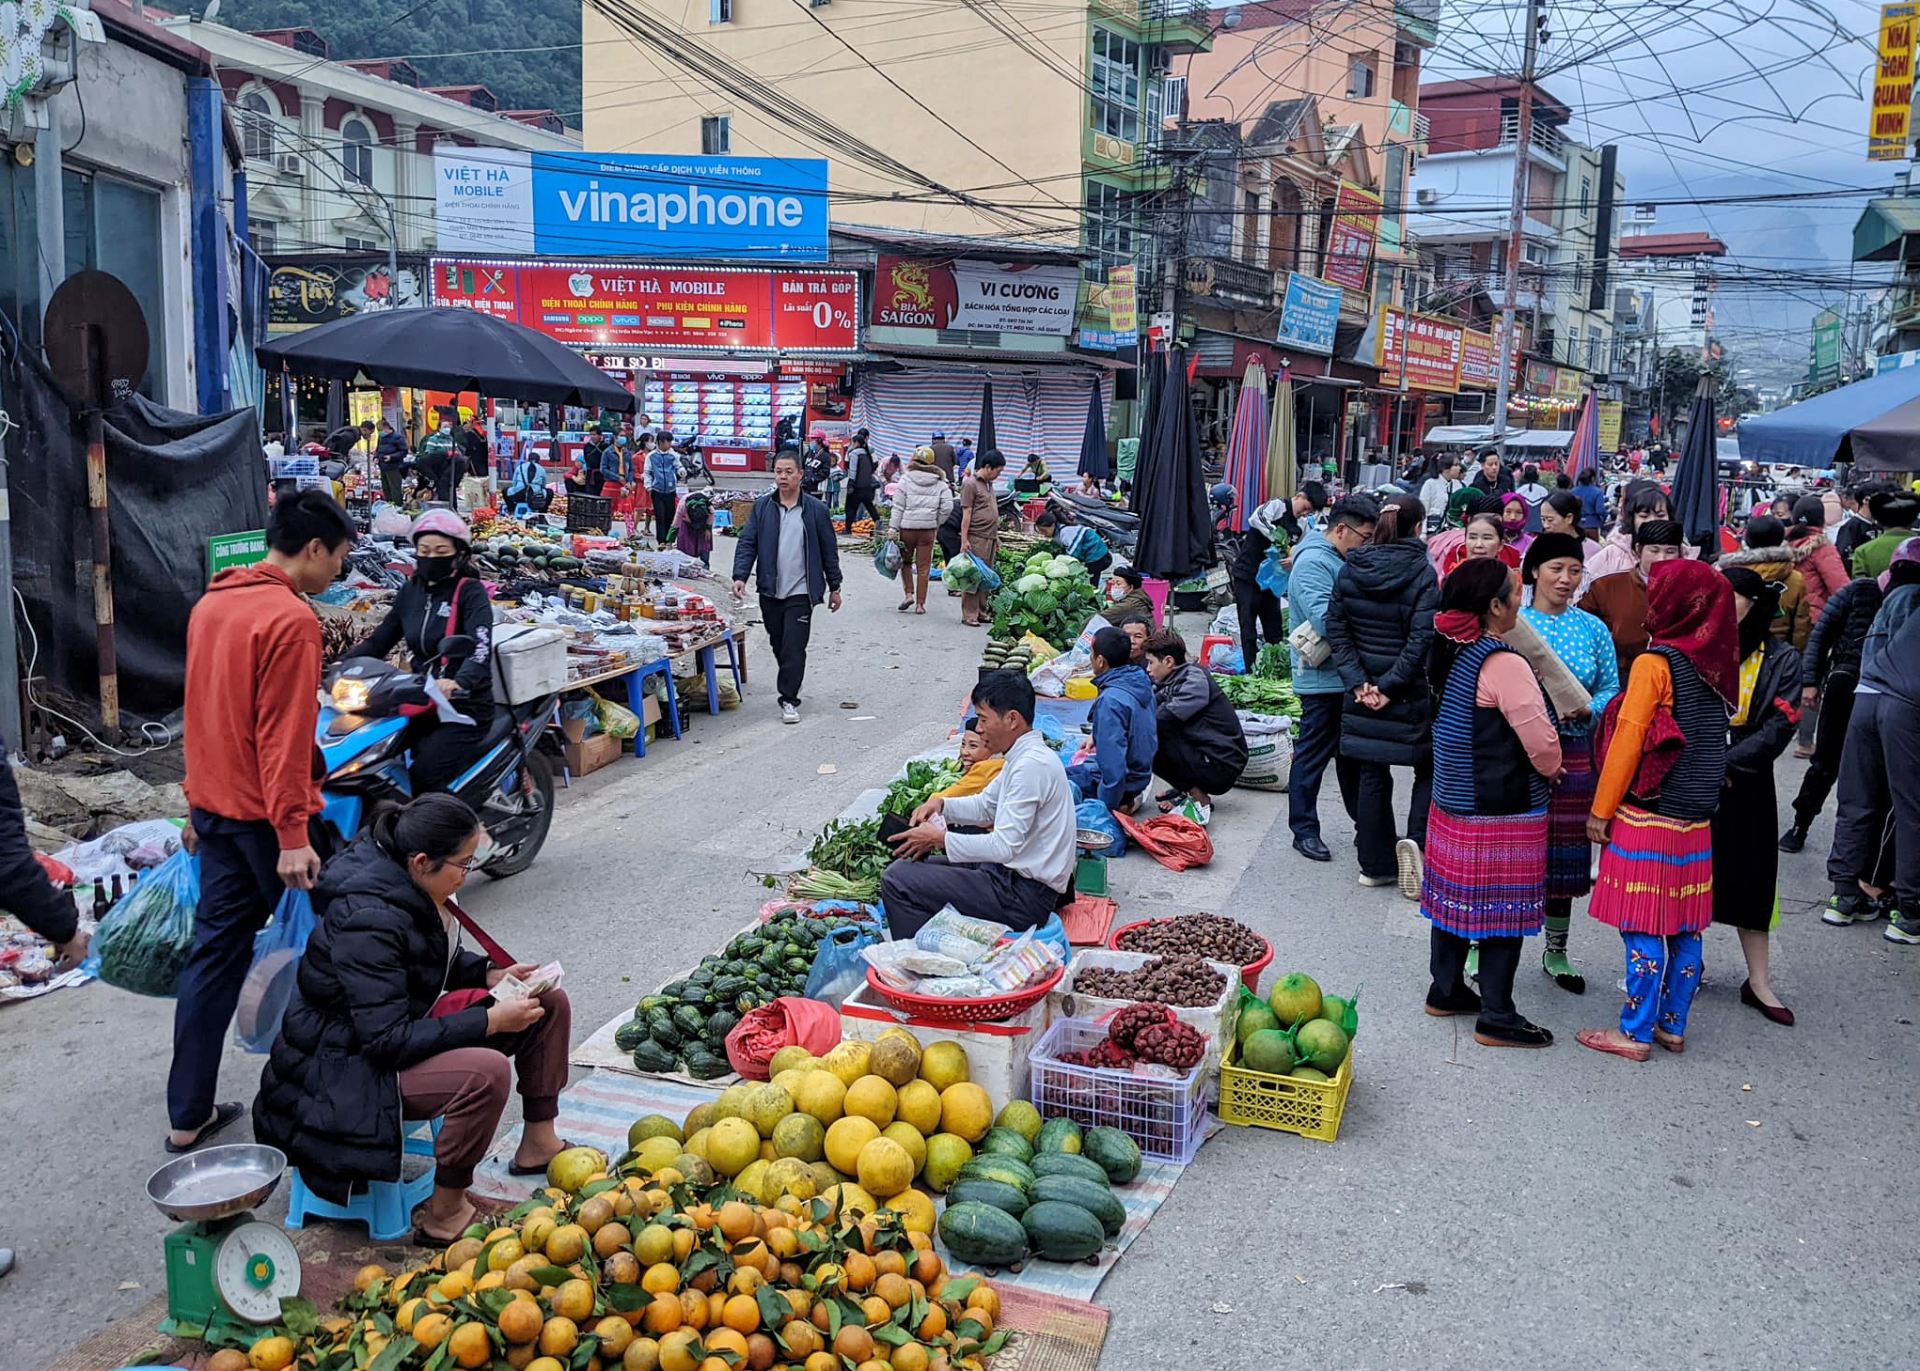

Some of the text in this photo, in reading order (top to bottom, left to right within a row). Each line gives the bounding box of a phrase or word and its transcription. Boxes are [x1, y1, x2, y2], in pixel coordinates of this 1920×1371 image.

[1876, 112, 1904, 135] MINH
[444, 165, 510, 183] VIỆT HÀ
[671, 164, 692, 175] DỊCH
[694, 165, 706, 174] VỤ
[731, 166, 761, 176] THÔNG
[453, 185, 504, 197] MOBILE
[558, 180, 803, 231] vinaphone
[600, 275, 725, 296] VIỆT HÀ MOBILE
[782, 278, 852, 294] BÁN TRẢ GÓP
[980, 282, 1060, 301] VI CƯƠNG
[475, 297, 491, 311] ĐIỆN
[493, 300, 514, 312] THOẠI
[541, 296, 748, 314] ĐIỆN THOẠI CHÍNH HÀNG PHỤ KIỆN CHÍNH HÀNG
[796, 300, 813, 312] suất
[900, 303, 918, 312] BIA
[964, 302, 984, 311] BÁCH
[1001, 303, 1022, 313] TỔNG
[1023, 306, 1038, 316] HỢP
[1038, 306, 1054, 315] CÁC
[1054, 308, 1070, 318] LOẠI
[880, 310, 935, 326] SAIGON
[603, 356, 625, 367] SIM
[215, 544, 230, 558] CÔNG
